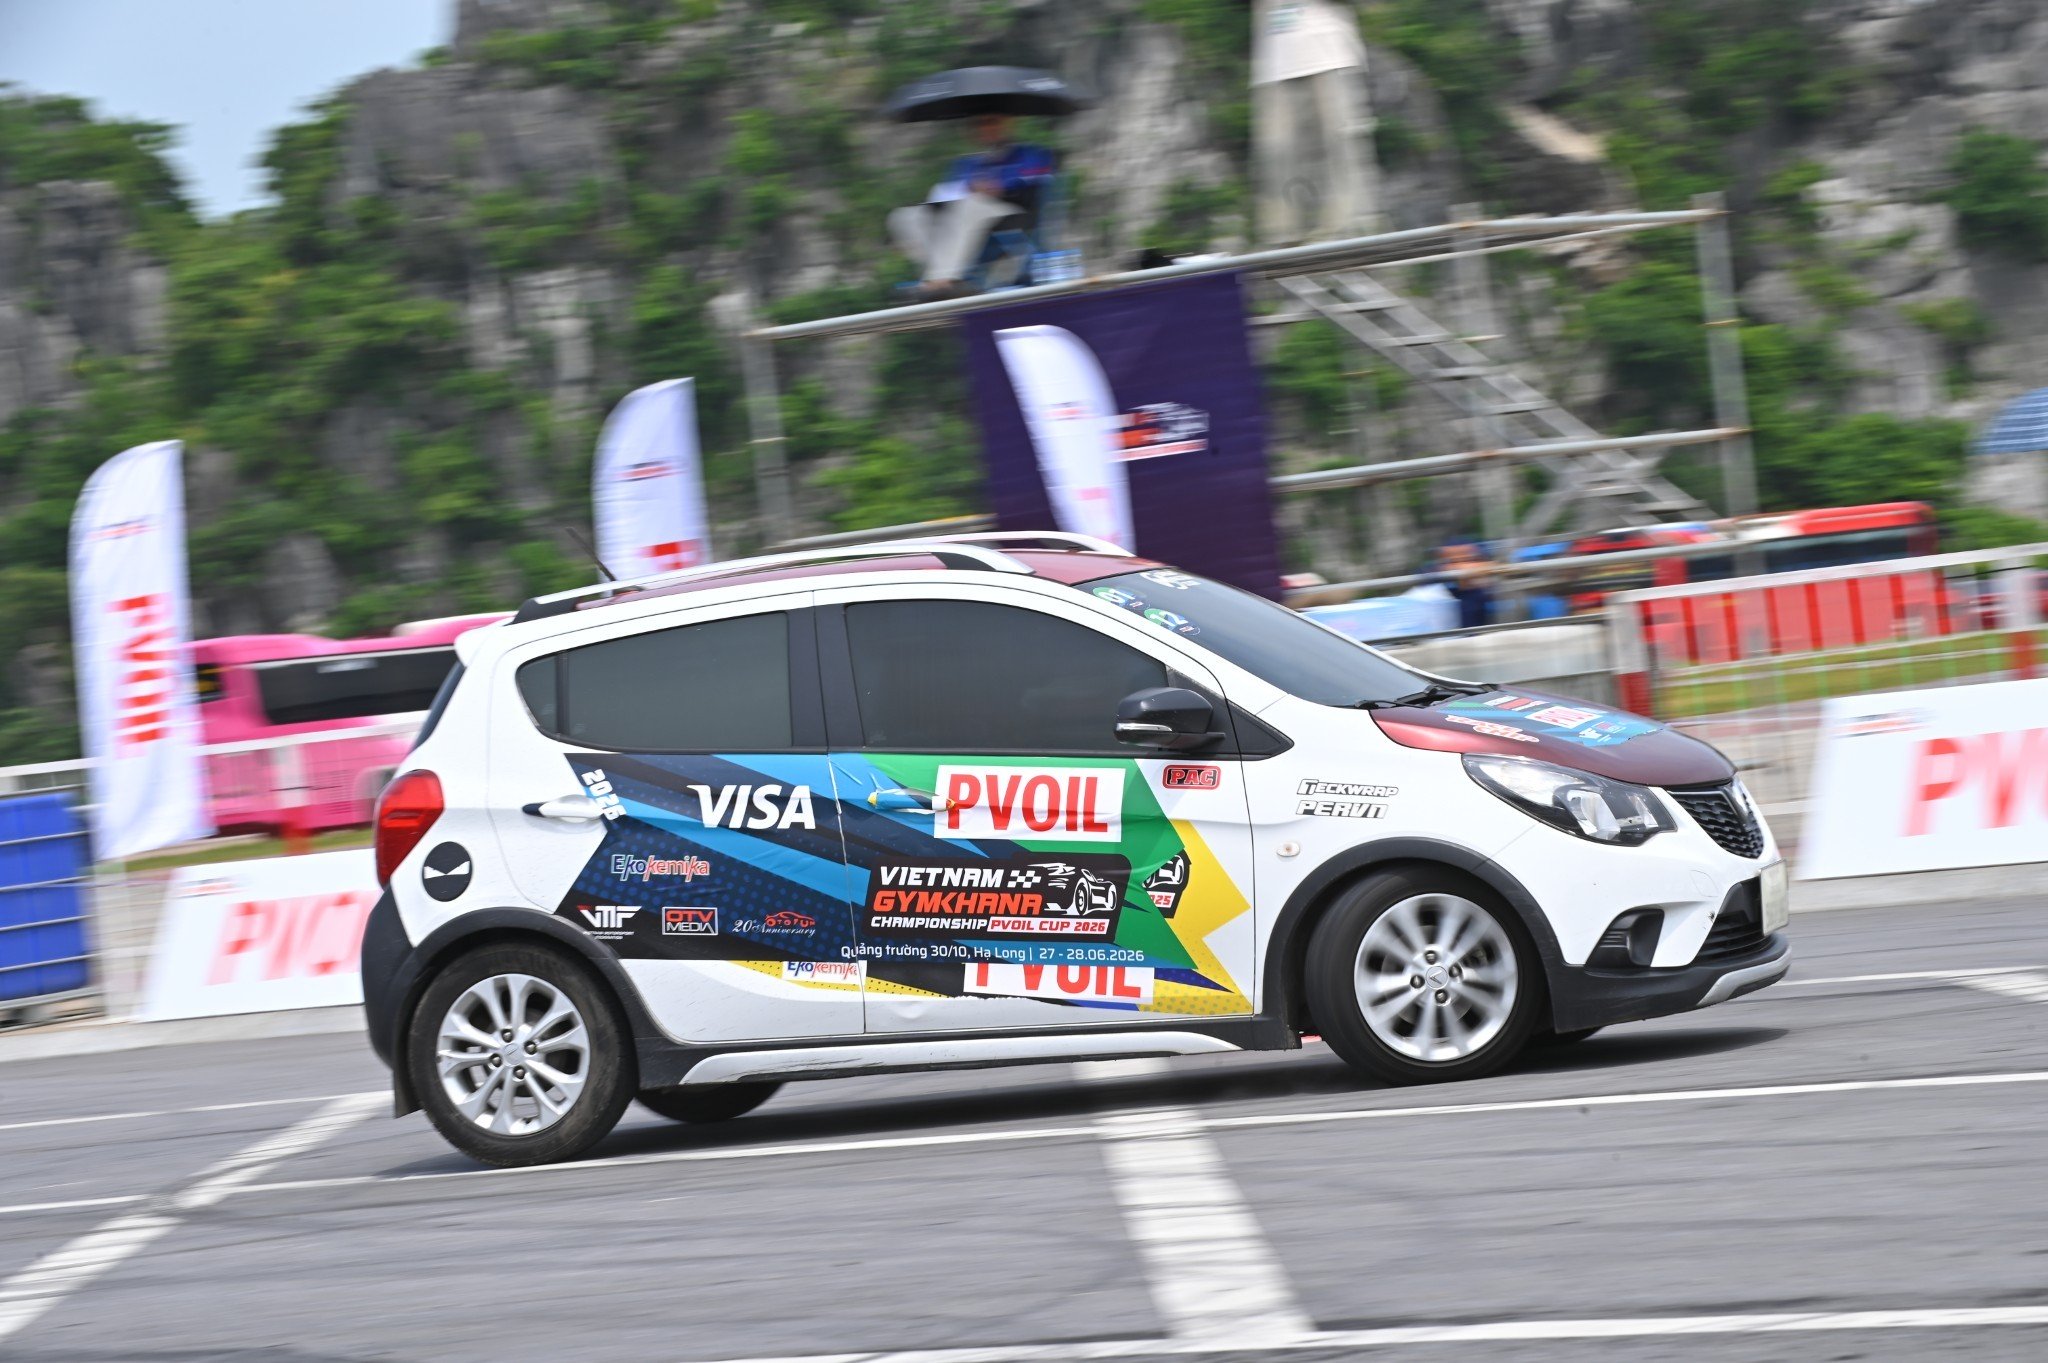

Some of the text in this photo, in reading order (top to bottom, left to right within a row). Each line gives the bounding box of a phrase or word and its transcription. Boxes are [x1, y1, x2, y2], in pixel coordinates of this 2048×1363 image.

[1169, 769, 1214, 786] PAC
[1296, 778, 1399, 798] TECKWRAP
[581, 768, 627, 821] 2026
[947, 773, 1108, 832] PVOIL
[686, 784, 816, 830] VISA
[611, 854, 710, 882] Ekokemika
[879, 866, 1005, 888] VIETNAM
[873, 890, 1043, 915] GYMKHANA
[665, 910, 714, 922] OTV
[870, 916, 1107, 932] CHAMPIONSHIP PVOIL CUP 2026
[666, 922, 715, 934] MEDIA
[840, 942, 882, 958] Quảng
[885, 944, 928, 959] trường
[930, 945, 971, 959] 30/10,
[974, 947, 991, 960] Hạ
[995, 947, 1026, 961] Long
[1039, 948, 1055, 960] 27
[1066, 948, 1145, 962] 28.06.2026
